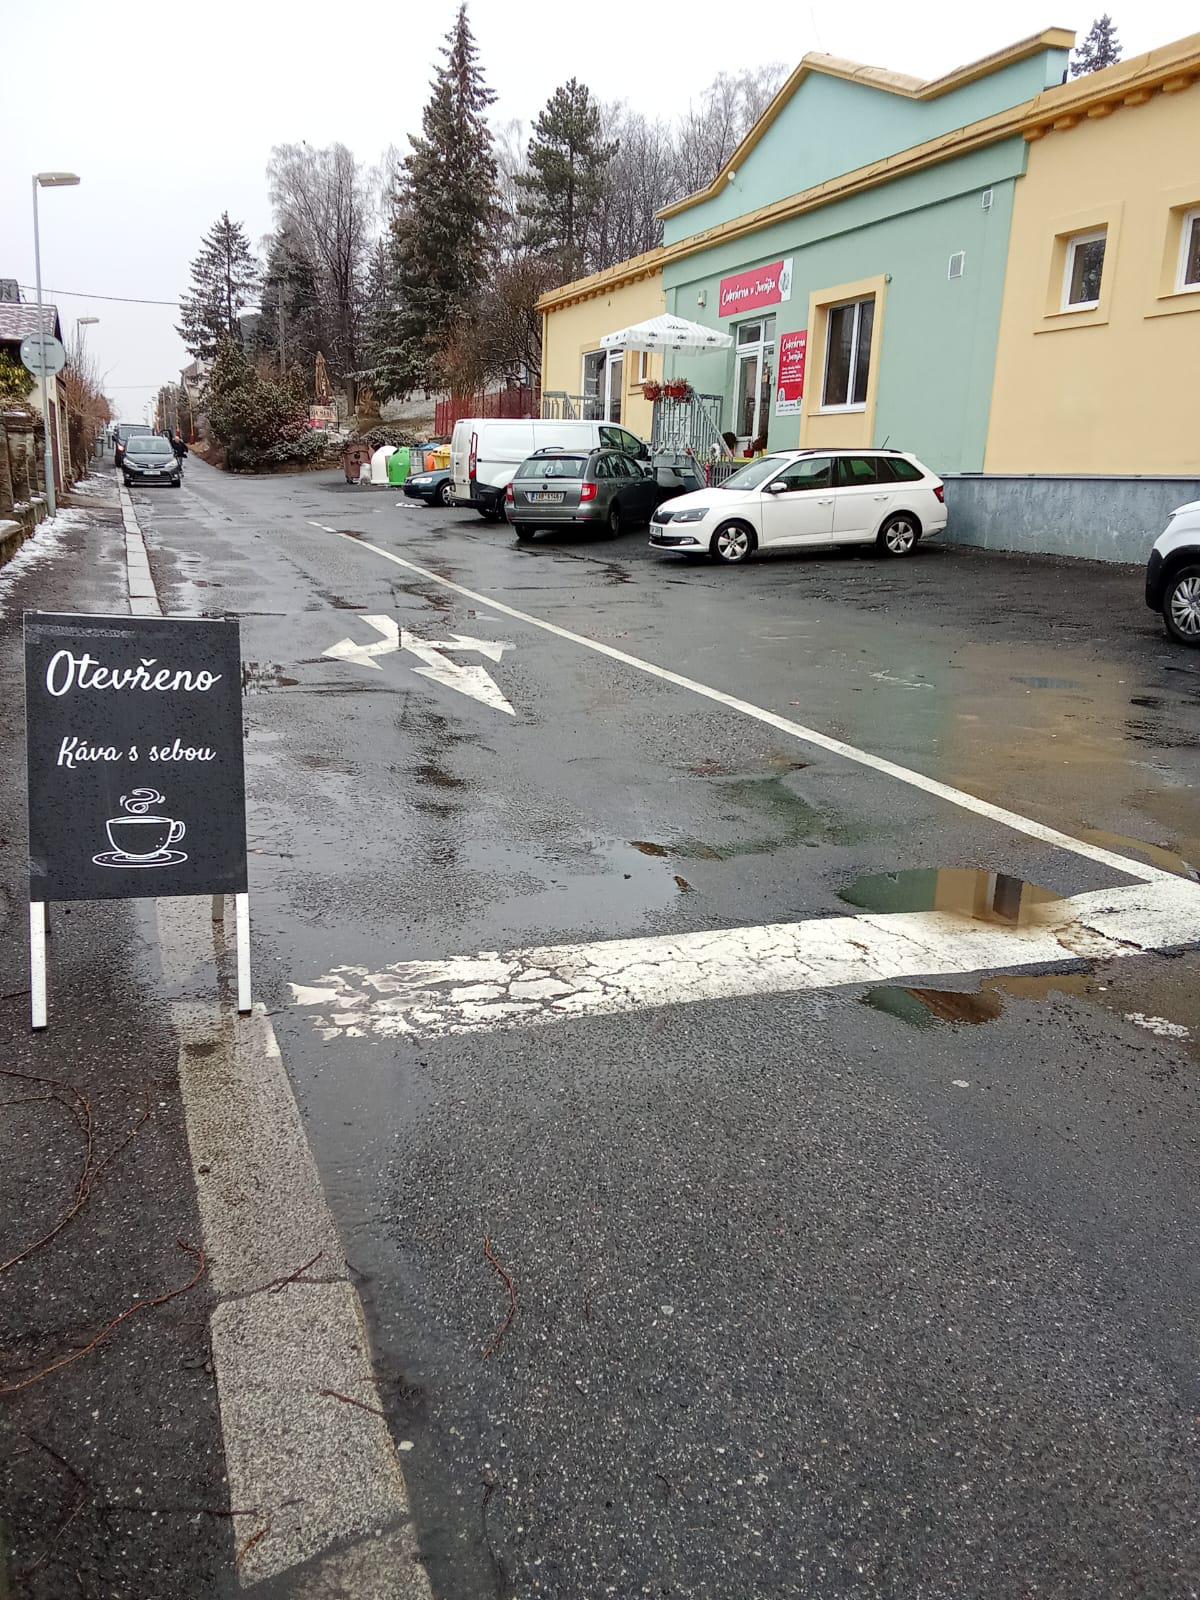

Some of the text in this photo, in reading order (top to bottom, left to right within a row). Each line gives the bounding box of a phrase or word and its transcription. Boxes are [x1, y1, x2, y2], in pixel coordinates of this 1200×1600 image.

[722, 285, 749, 306] Cukrárna
[782, 336, 805, 352] Cukrárna
[46, 650, 222, 696] Otevřeno
[57, 736, 217, 769] Káva s sebou
